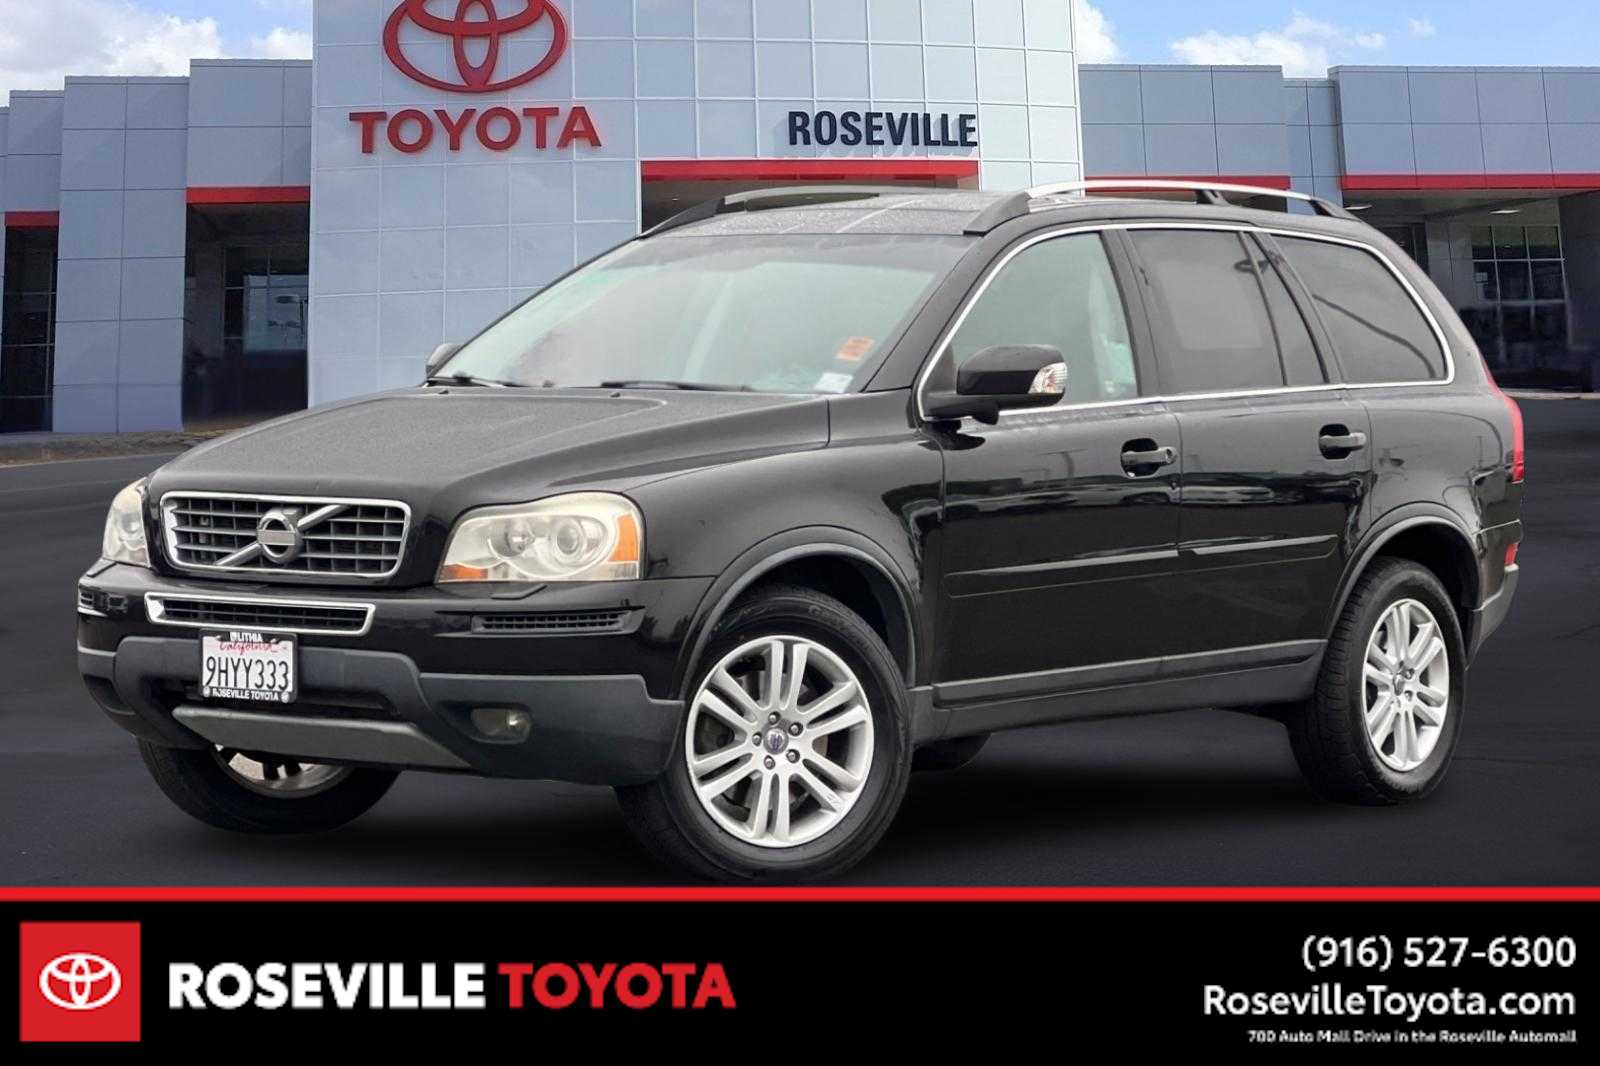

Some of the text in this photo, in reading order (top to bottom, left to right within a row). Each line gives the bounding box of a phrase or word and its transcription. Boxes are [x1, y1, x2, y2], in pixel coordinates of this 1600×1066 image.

[349, 106, 602, 153] TOYOTA
[788, 110, 978, 147] ROSEVILLE
[206, 656, 289, 691] 9HYY333
[212, 688, 279, 701] ROSEVILLE TOYOTA
